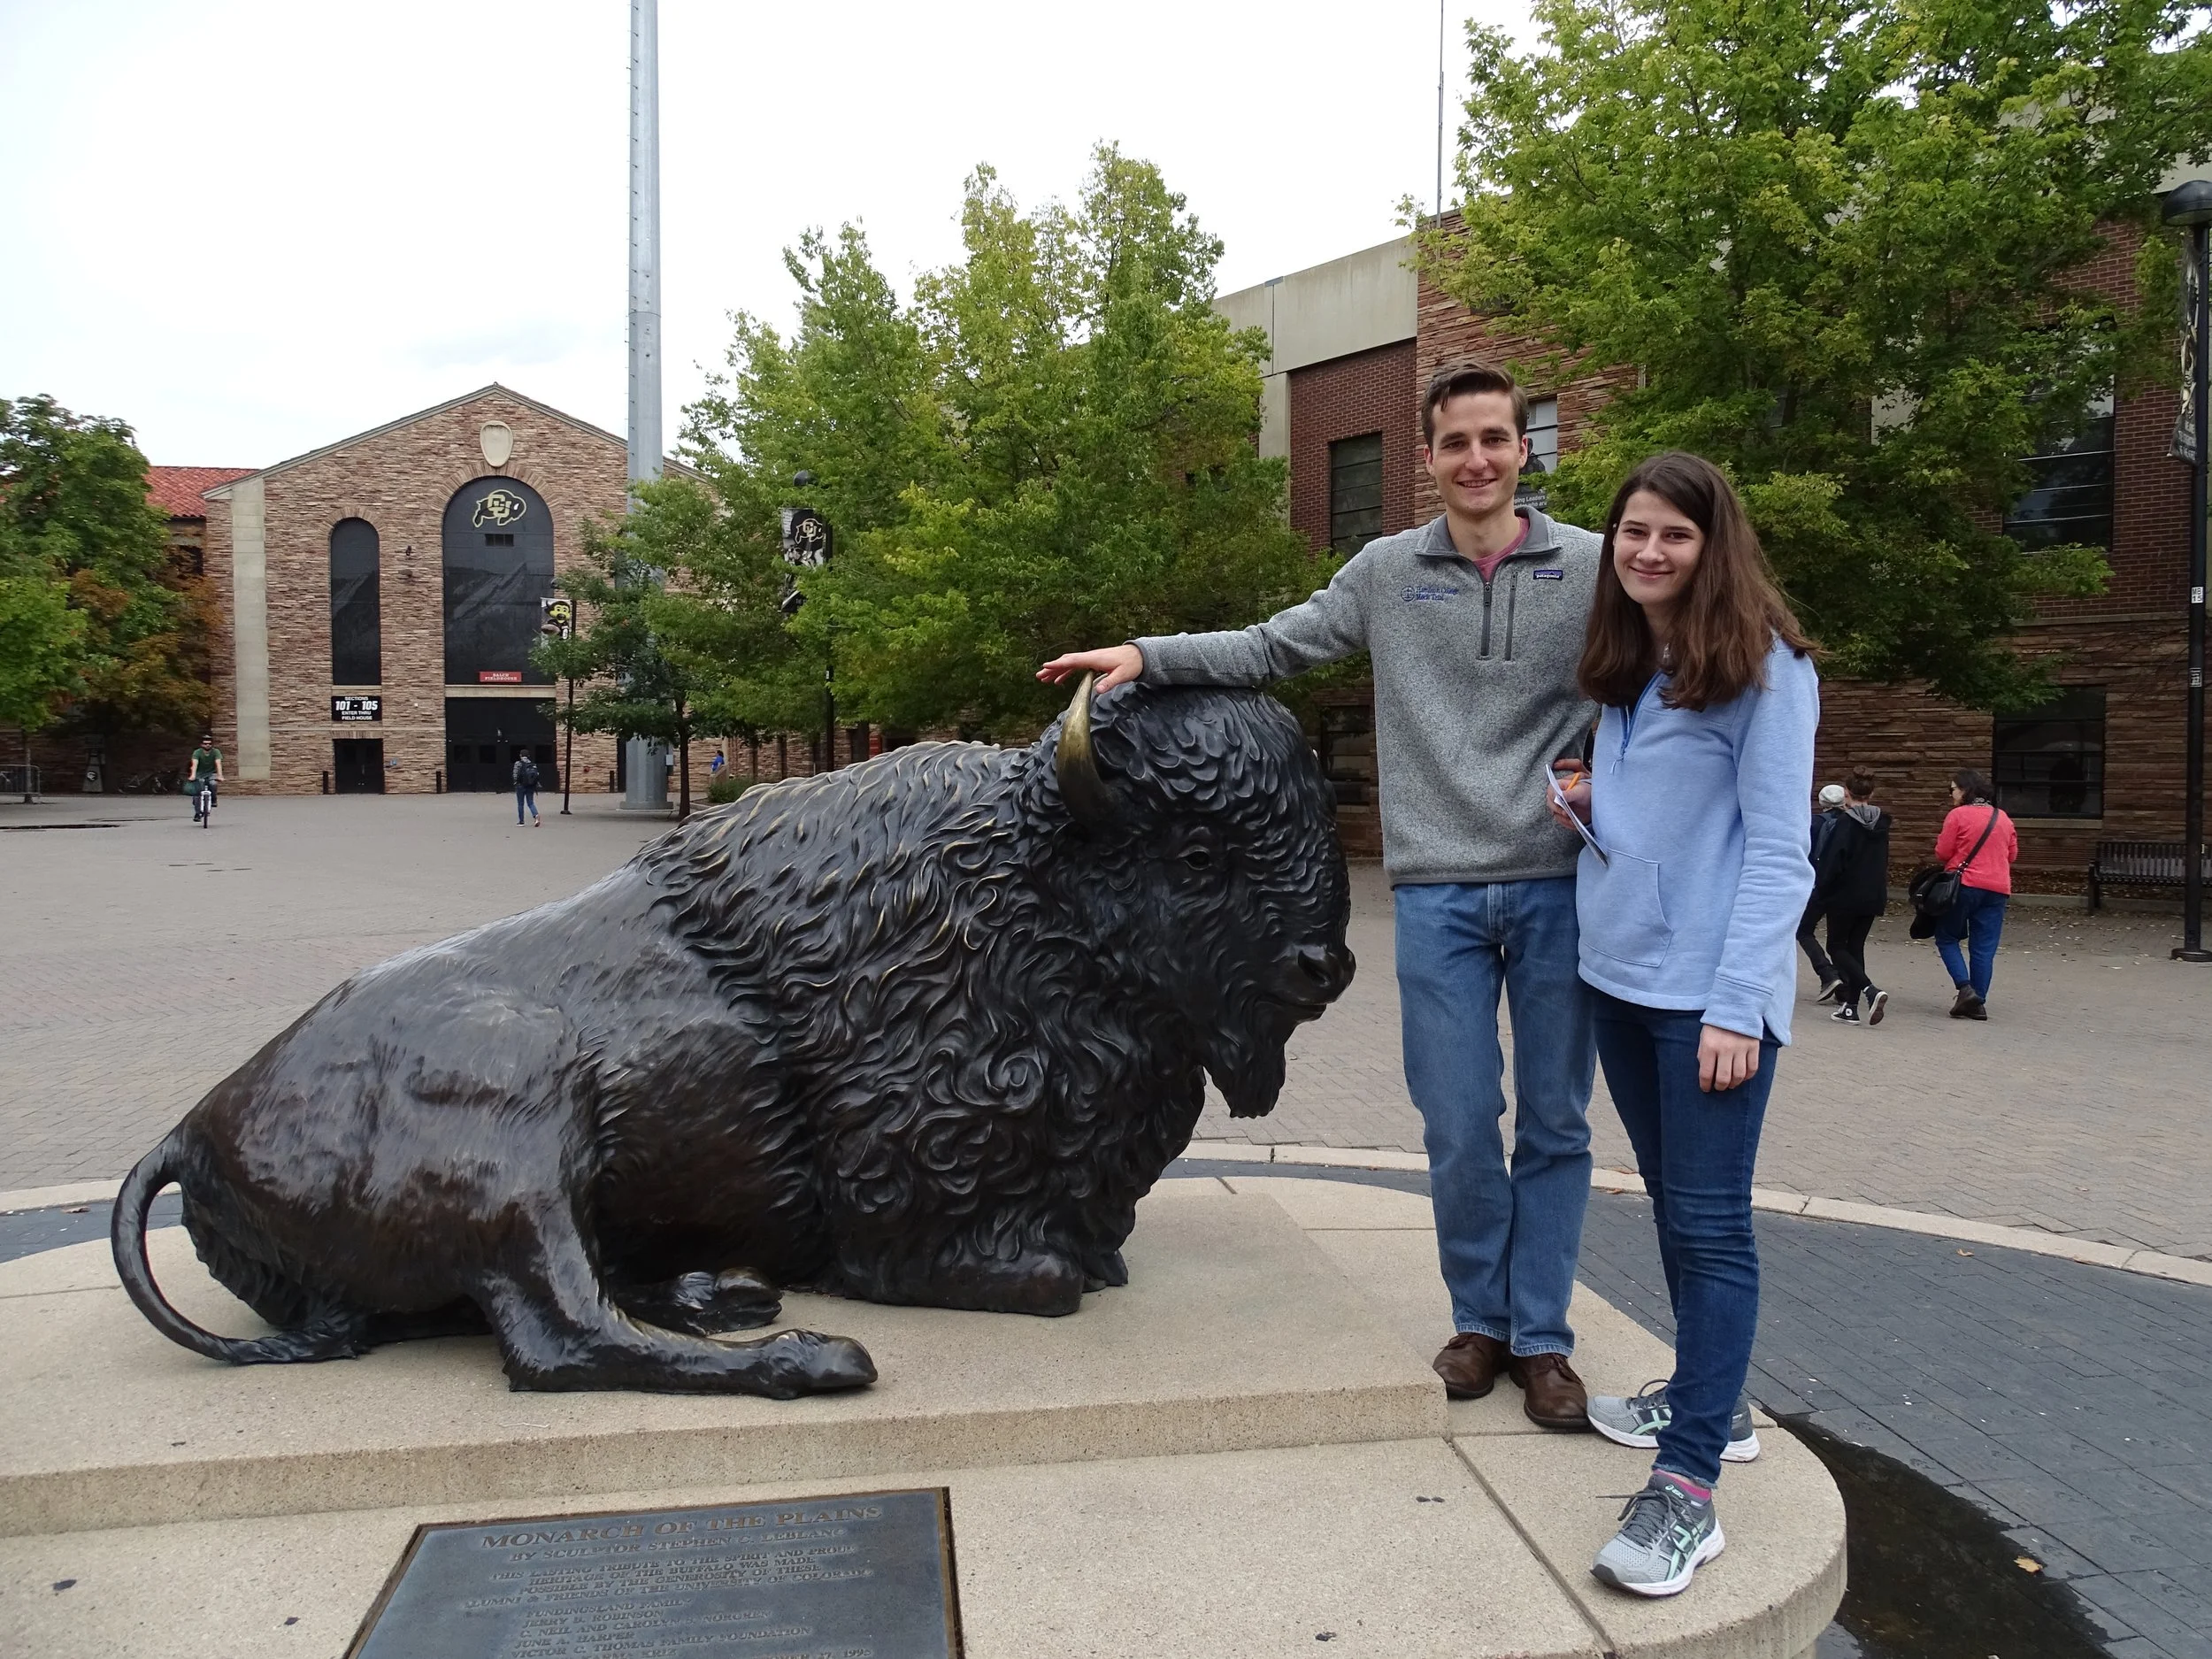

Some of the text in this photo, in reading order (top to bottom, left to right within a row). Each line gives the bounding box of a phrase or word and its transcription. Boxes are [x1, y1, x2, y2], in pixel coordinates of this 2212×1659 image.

[335, 701, 350, 710] 101
[362, 701, 379, 710] 105
[482, 1507, 882, 1548] MONARCH OF THE PLAINS
[510, 1551, 537, 1562] BY
[544, 1543, 641, 1559] SCULPTOR
[648, 1536, 732, 1551] STEPHEN
[600, 1561, 659, 1572] TRIBUTE
[692, 1556, 719, 1565] THE
[725, 1551, 771, 1563] SPIRIT
[774, 1549, 803, 1558] AND
[529, 1573, 603, 1586] HERITAGE
[635, 1568, 664, 1577] THE
[669, 1563, 734, 1575] BUFFALO
[740, 1560, 769, 1569] WAS
[774, 1556, 816, 1566] MADE
[594, 1580, 615, 1589] BY
[619, 1578, 649, 1586] THE
[655, 1570, 748, 1584] GENEROSITY
[776, 1564, 821, 1575] THESE
[544, 1590, 610, 1601] FRIENDS
[614, 1587, 635, 1596] OF
[640, 1585, 671, 1594] THE
[673, 1577, 763, 1591] UNIVERSITY
[522, 1617, 568, 1628] JERRY
[592, 1609, 664, 1622] ROBINSON
[538, 1625, 572, 1636] NEIL
[577, 1624, 608, 1633] AND
[511, 1647, 567, 1658] VICTOR
[593, 1640, 655, 1652] THOMAS
[513, 1638, 553, 1649] JUNE
